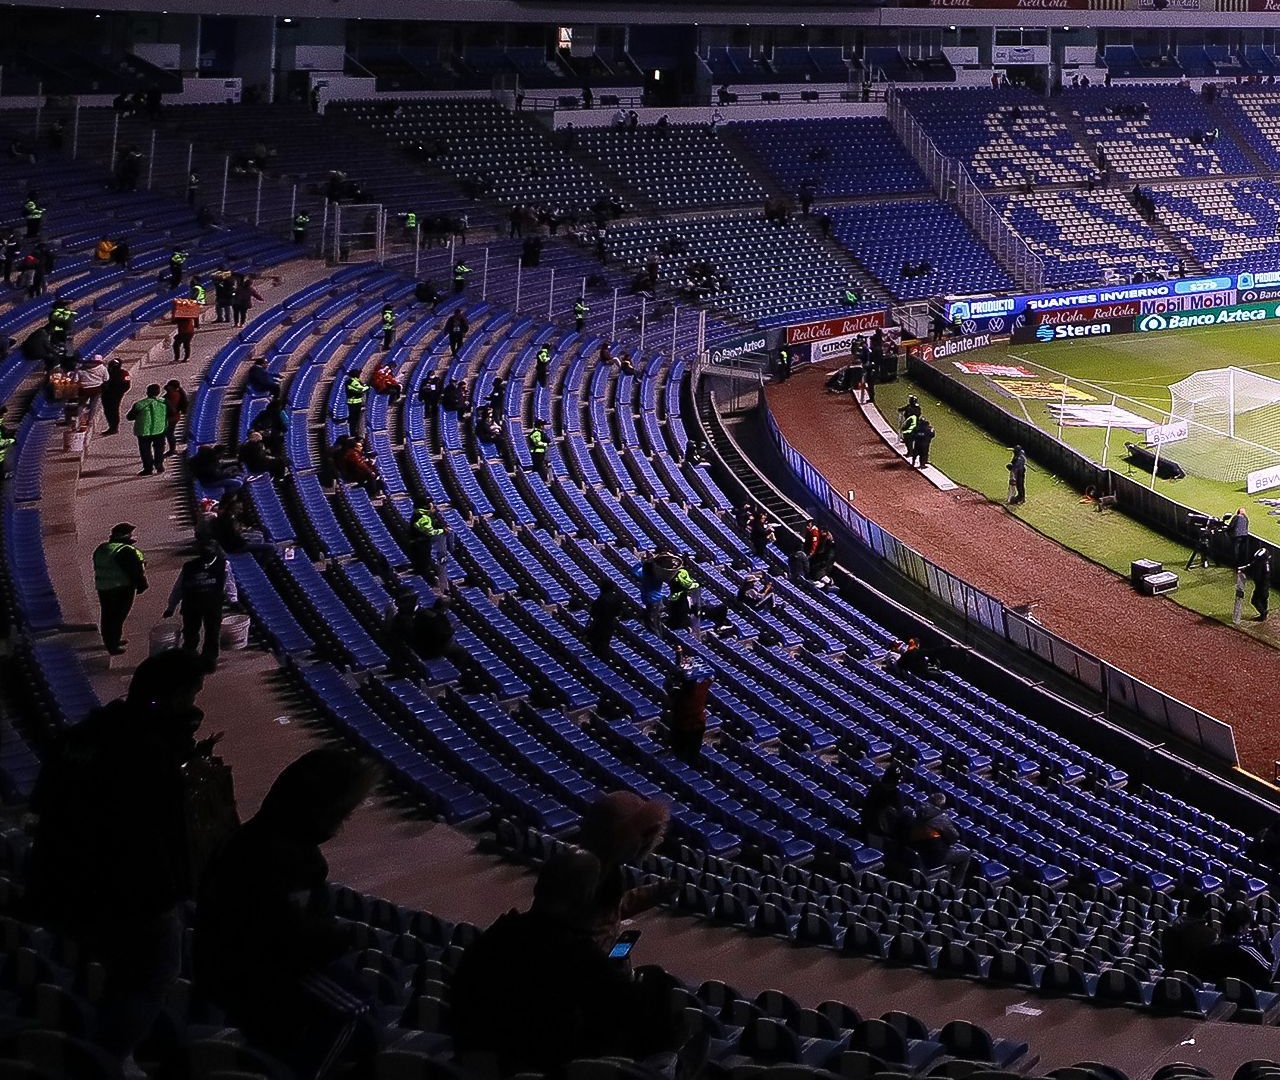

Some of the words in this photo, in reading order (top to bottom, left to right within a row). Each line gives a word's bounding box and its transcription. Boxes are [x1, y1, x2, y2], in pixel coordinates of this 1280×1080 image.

[1100, 286, 1168, 301] INVIERNO
[971, 299, 1014, 313] PRODUCTO
[1142, 298, 1184, 315] Mobil
[1191, 293, 1231, 309] Mobil
[1169, 314, 1215, 328] Banco
[1217, 309, 1266, 324] Azteca
[1056, 323, 1110, 338] Steren
[743, 339, 765, 353] Azteca
[934, 334, 990, 358] caliente.mx
[1256, 475, 1280, 488] BBVA
